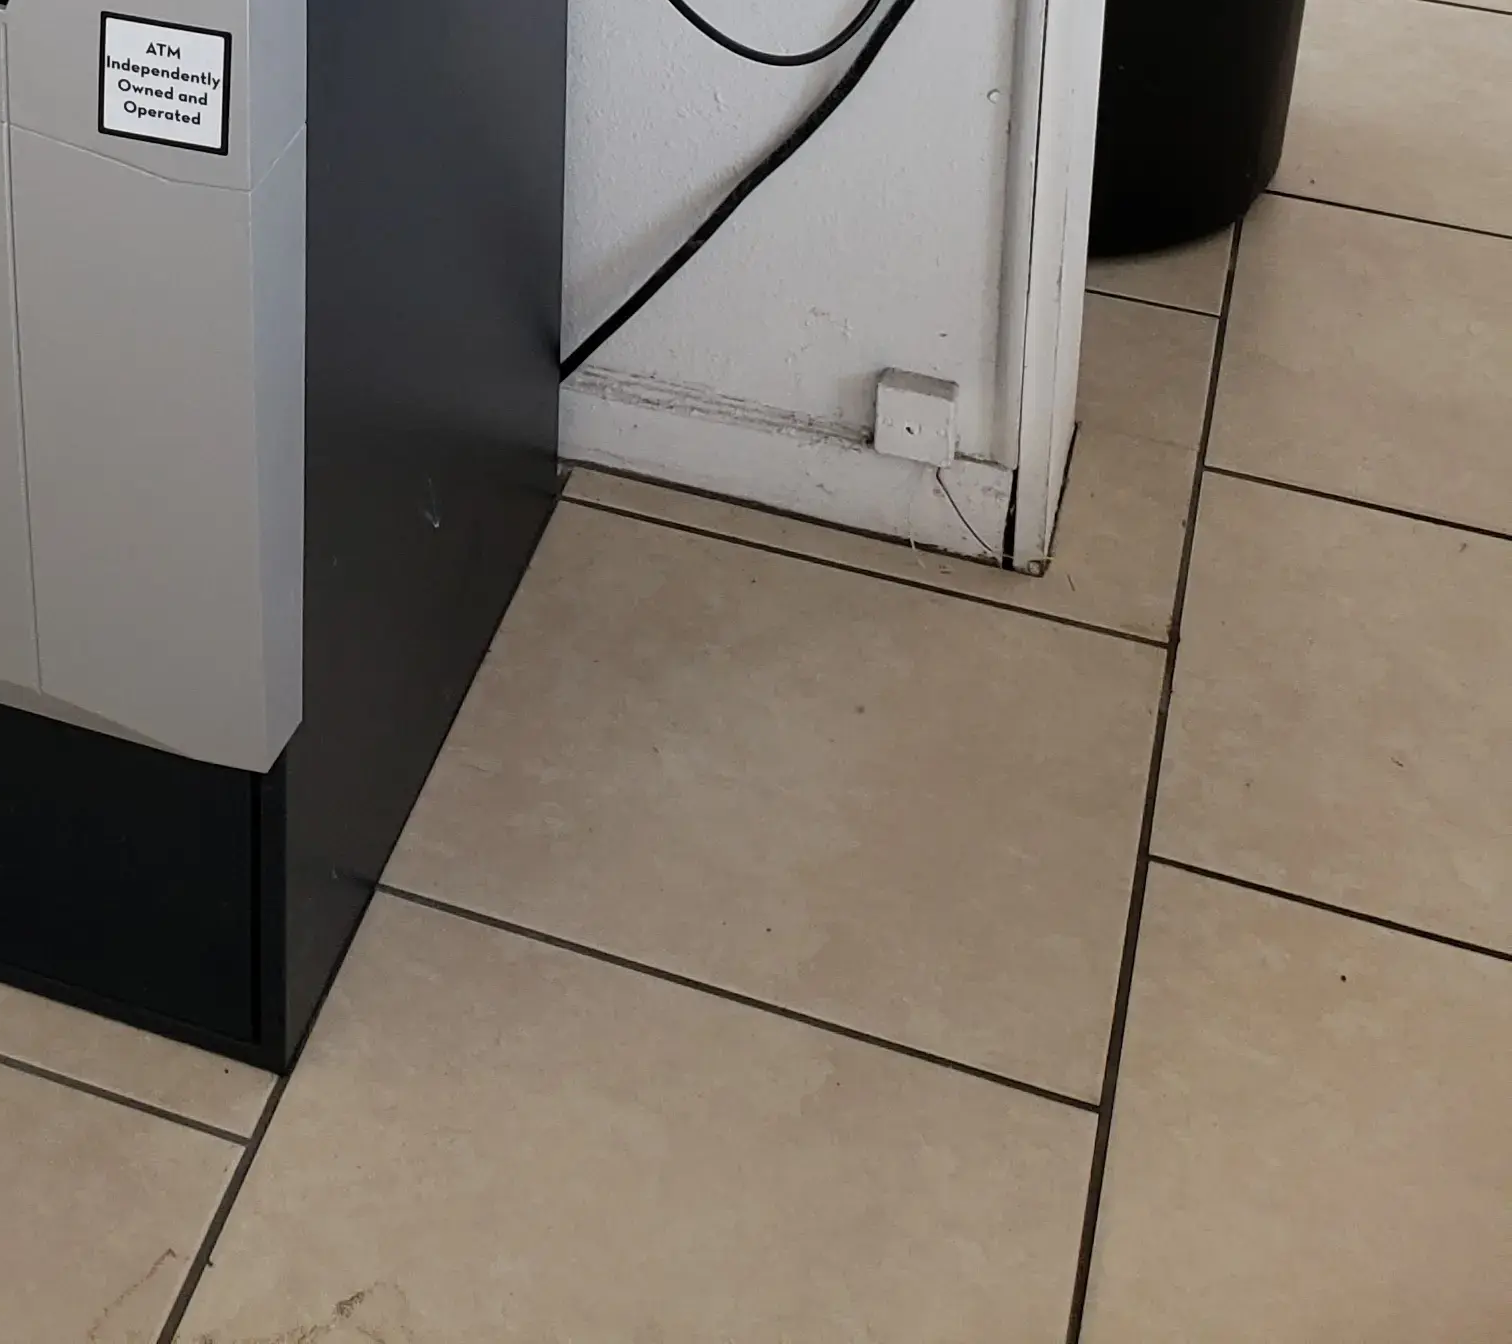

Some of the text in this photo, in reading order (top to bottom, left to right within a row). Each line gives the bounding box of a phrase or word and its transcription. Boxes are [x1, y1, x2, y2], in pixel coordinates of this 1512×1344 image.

[145, 42, 181, 60] ATM
[106, 55, 221, 91] Independently
[117, 78, 208, 106] Owned and
[123, 100, 202, 125] Operated
